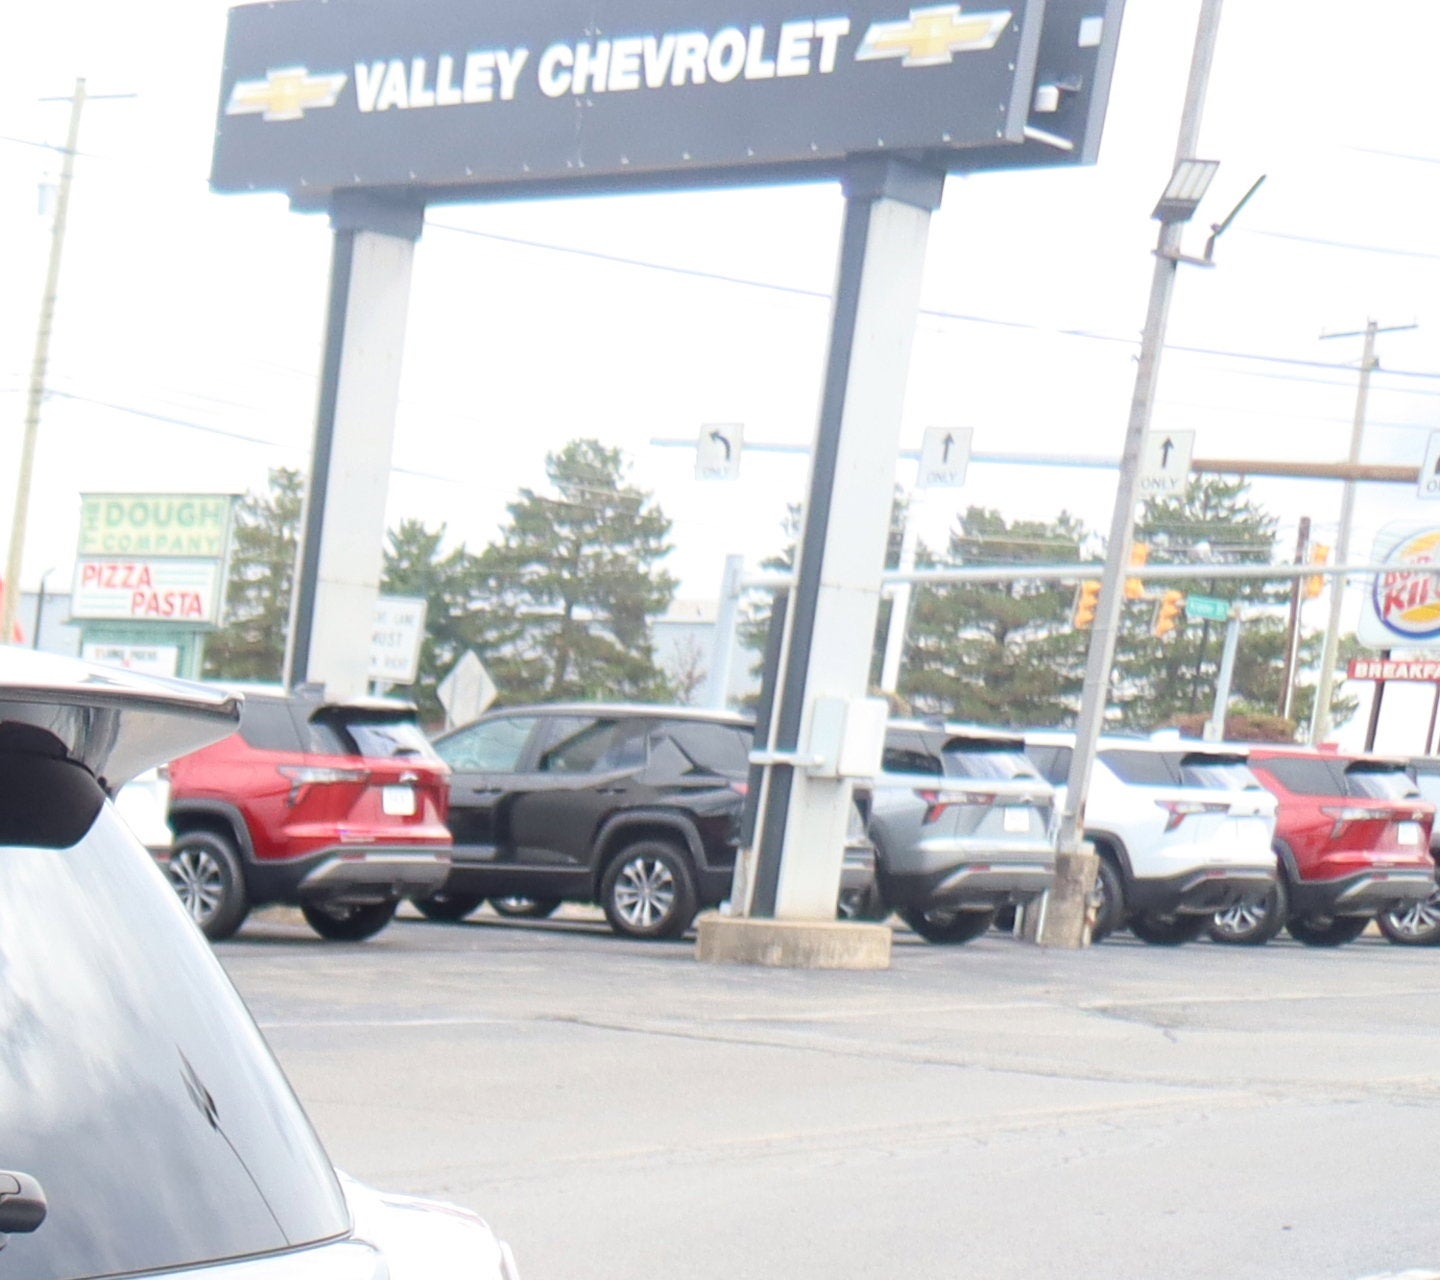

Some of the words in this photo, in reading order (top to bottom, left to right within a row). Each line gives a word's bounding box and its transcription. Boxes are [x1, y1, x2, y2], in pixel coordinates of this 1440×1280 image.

[354, 50, 527, 112] VALLEY
[537, 18, 851, 98] CHEVROLET
[104, 501, 222, 528] DOUGH
[101, 533, 219, 551] COMPANY
[82, 564, 152, 589] PIZZA
[131, 591, 203, 617] PASTA
